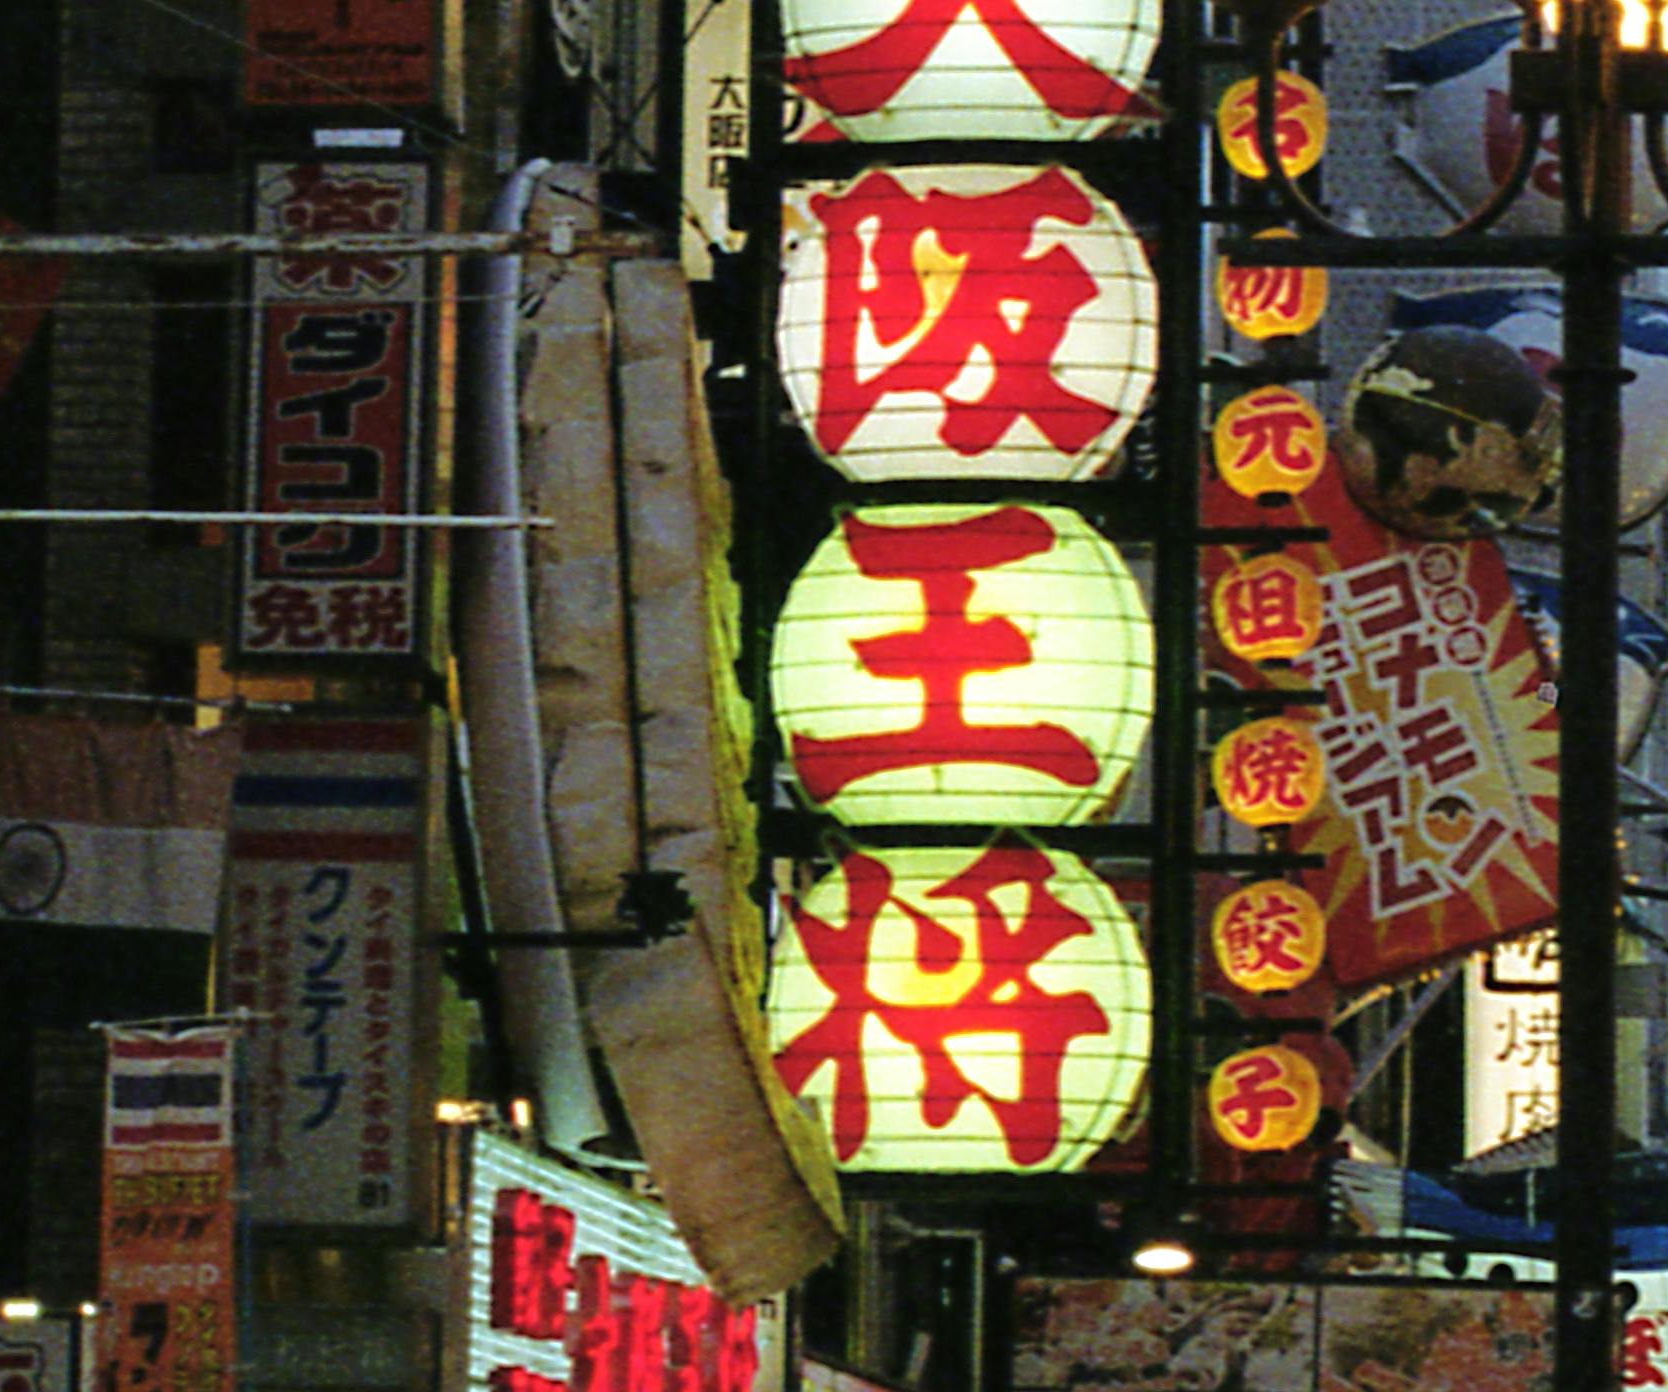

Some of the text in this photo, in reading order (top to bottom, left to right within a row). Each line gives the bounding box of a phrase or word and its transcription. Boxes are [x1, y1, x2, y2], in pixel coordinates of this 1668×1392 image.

[278, 312, 395, 570] ダイコク
[250, 585, 407, 648] 免税
[1345, 553, 1505, 881] コナモン
[297, 867, 352, 1130] クンテープ
